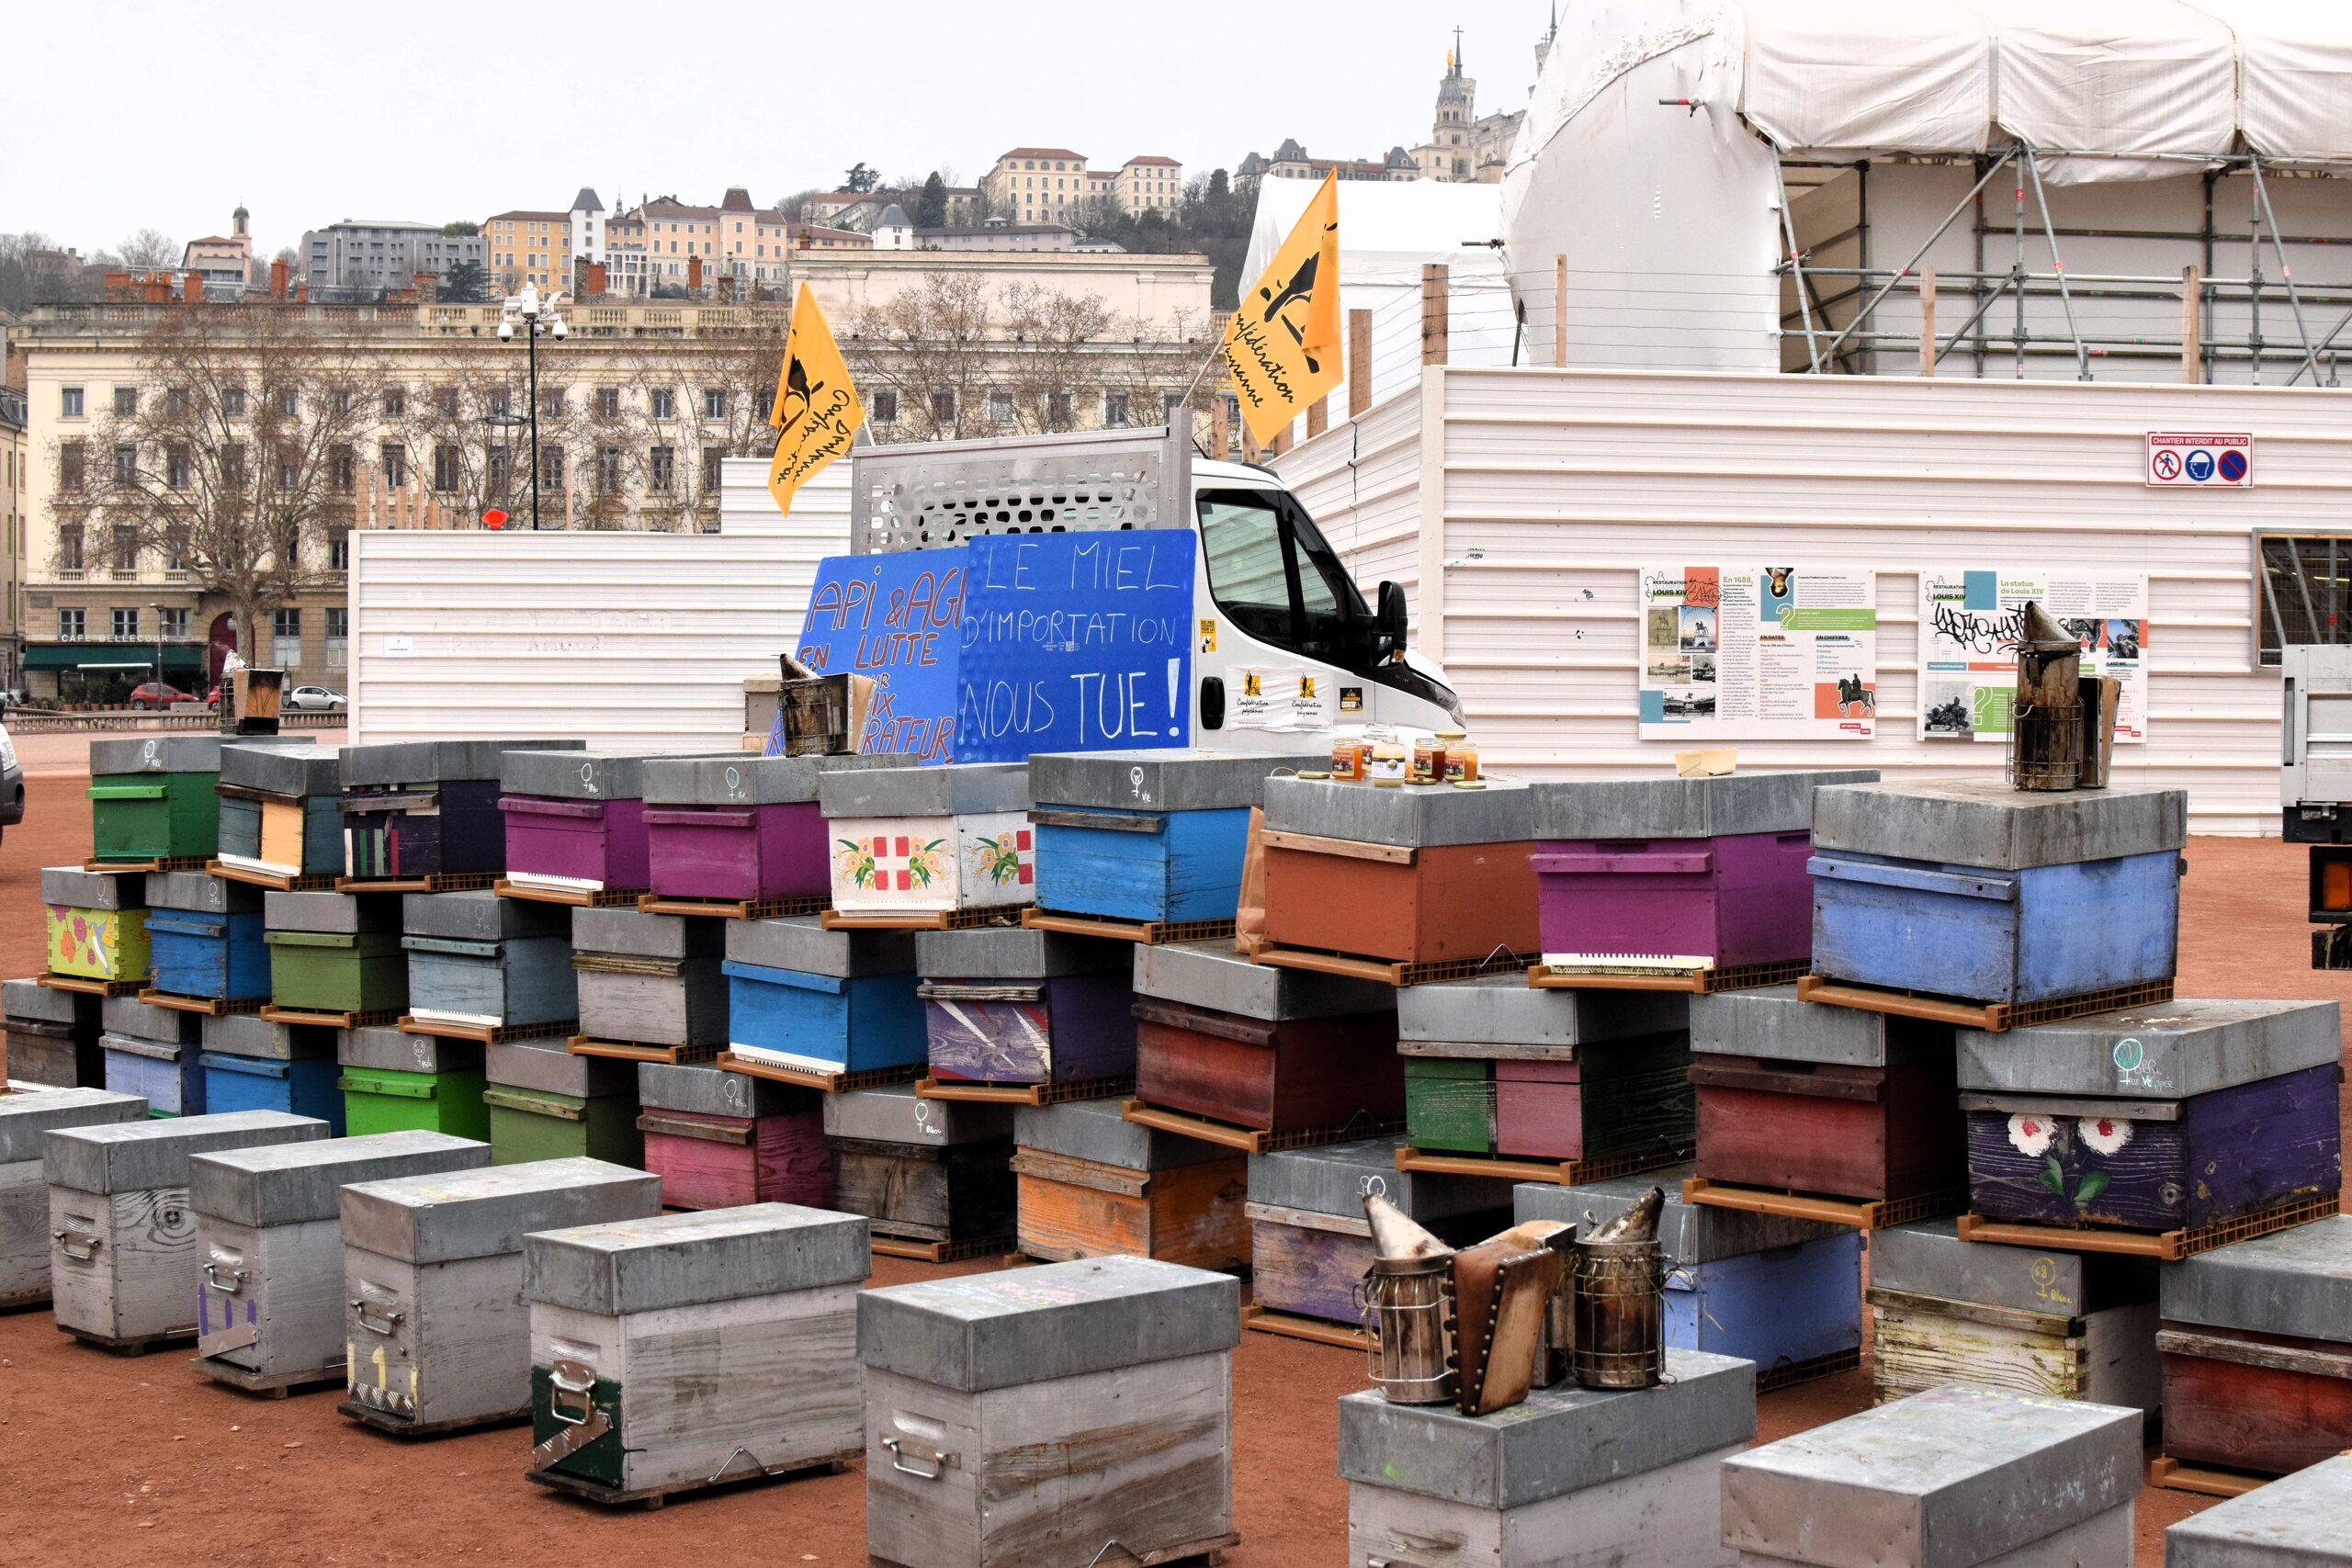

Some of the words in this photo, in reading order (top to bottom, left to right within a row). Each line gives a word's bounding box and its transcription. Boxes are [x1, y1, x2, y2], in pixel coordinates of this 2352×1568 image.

[986, 544, 1039, 590] LE
[1071, 541, 1180, 591] MIEL
[98, 634, 168, 642] BELLECOUR
[962, 608, 1176, 649] D'IMPORTATION
[797, 644, 831, 670] EN
[854, 632, 939, 669] LUTTE
[961, 680, 1055, 741] NOUS
[1070, 672, 1158, 744] TUE
